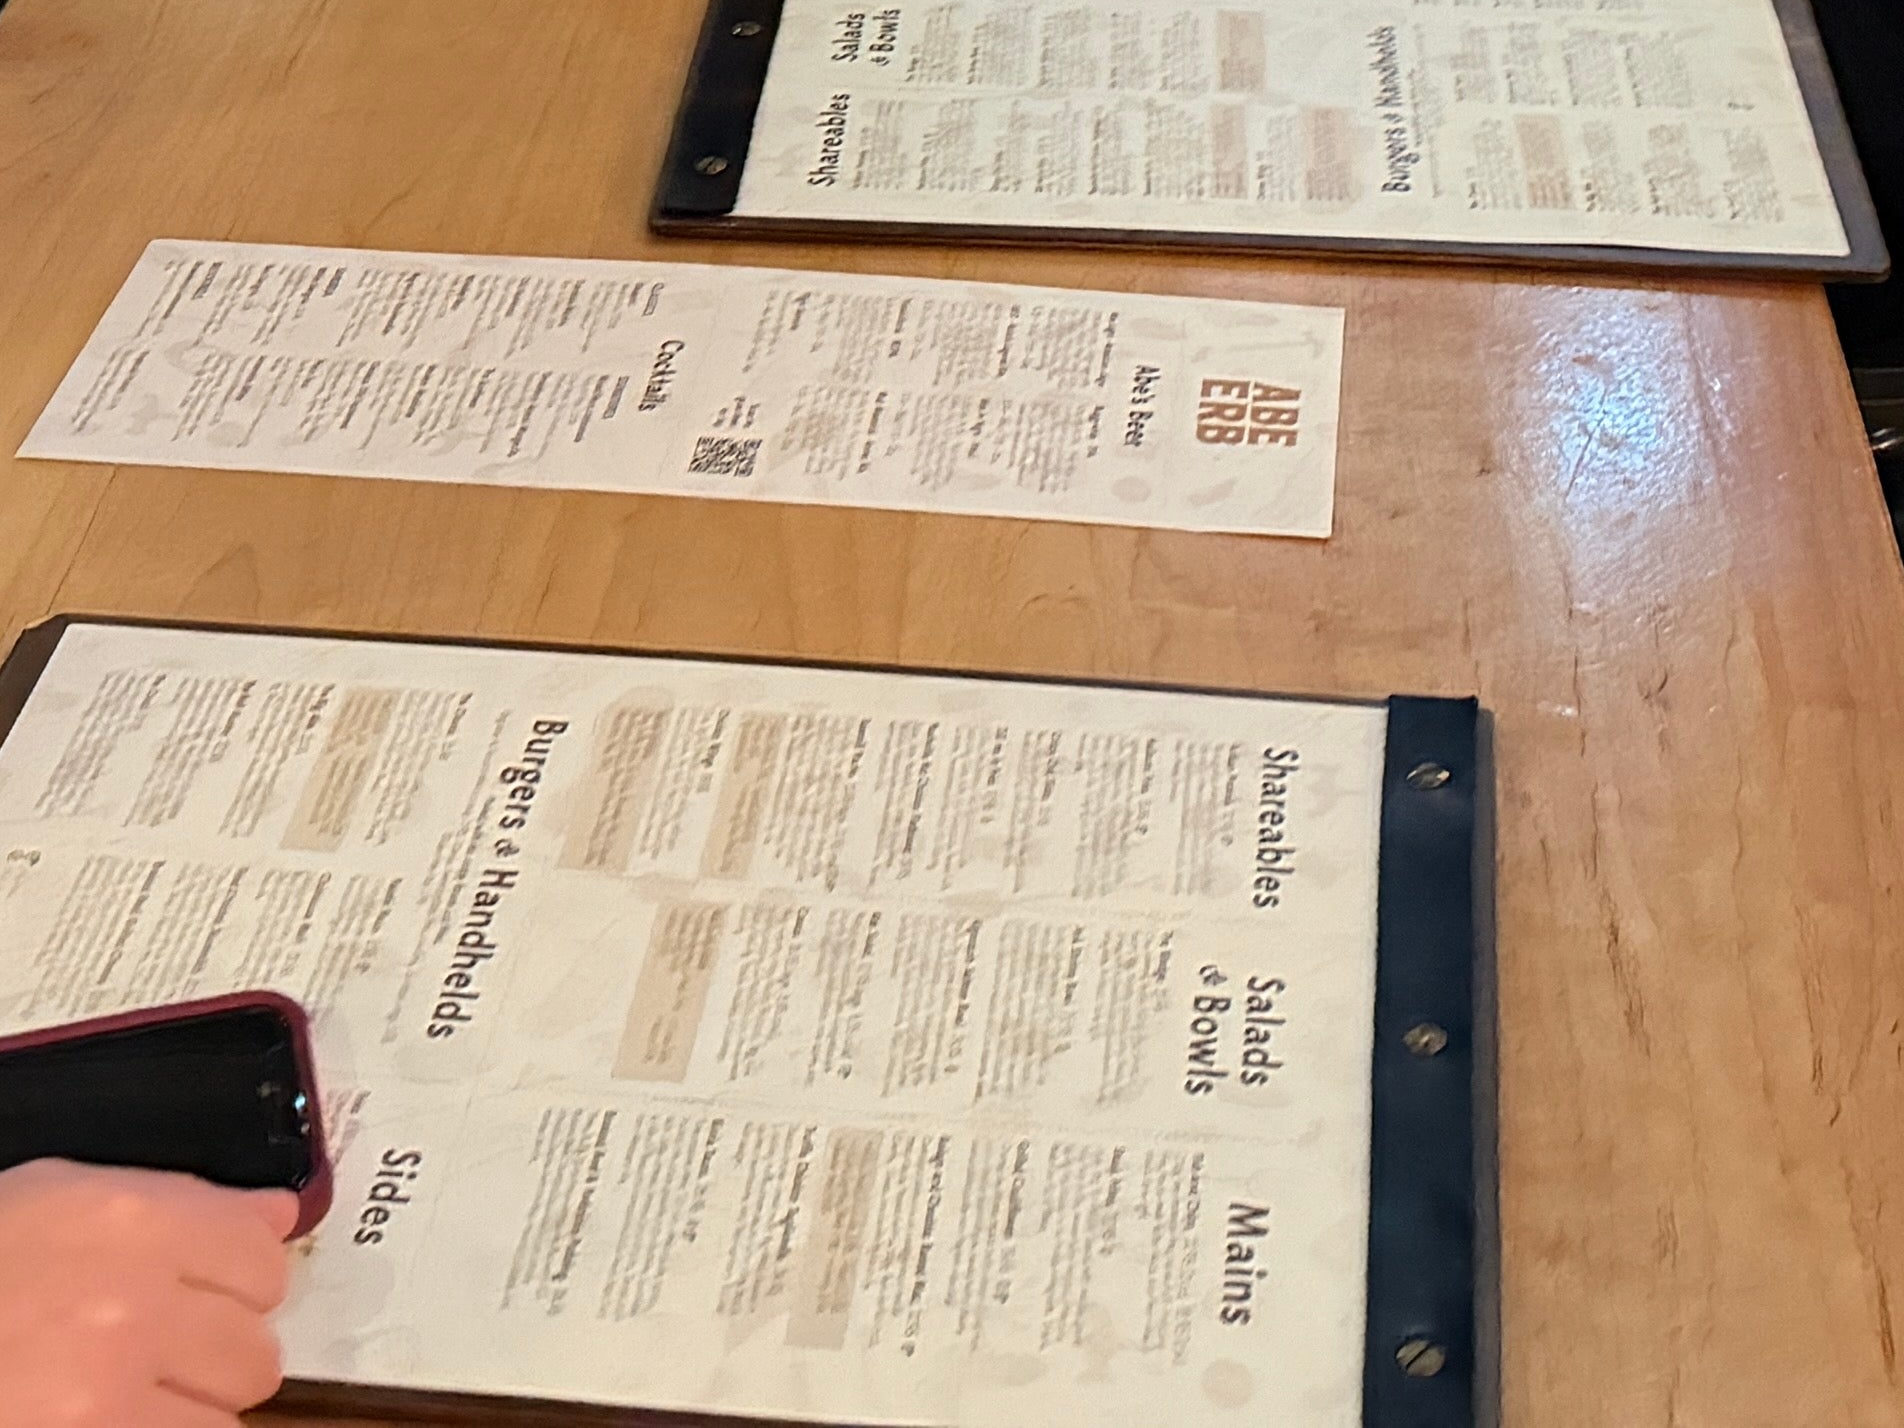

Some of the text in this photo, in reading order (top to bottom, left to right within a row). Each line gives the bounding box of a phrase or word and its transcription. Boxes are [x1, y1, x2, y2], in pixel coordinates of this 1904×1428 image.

[831, 13, 865, 62] Salads
[871, 8, 901, 50] Bowls
[1367, 25, 1400, 109] Handhelds
[808, 93, 851, 187] Shareables
[1382, 129, 1420, 194] Burgers
[637, 339, 685, 412] Cocktails
[1196, 378, 1247, 446] ERB
[1247, 380, 1302, 448] ABE
[1123, 410, 1152, 449] Beer
[500, 717, 569, 832] Burgers
[1255, 746, 1300, 911] Shareables
[427, 866, 520, 1041] Handhelds
[1185, 986, 1233, 1098] Bowls
[1241, 976, 1287, 1089] Salads
[353, 1147, 422, 1247] Sides
[1220, 1201, 1271, 1328] Mains
